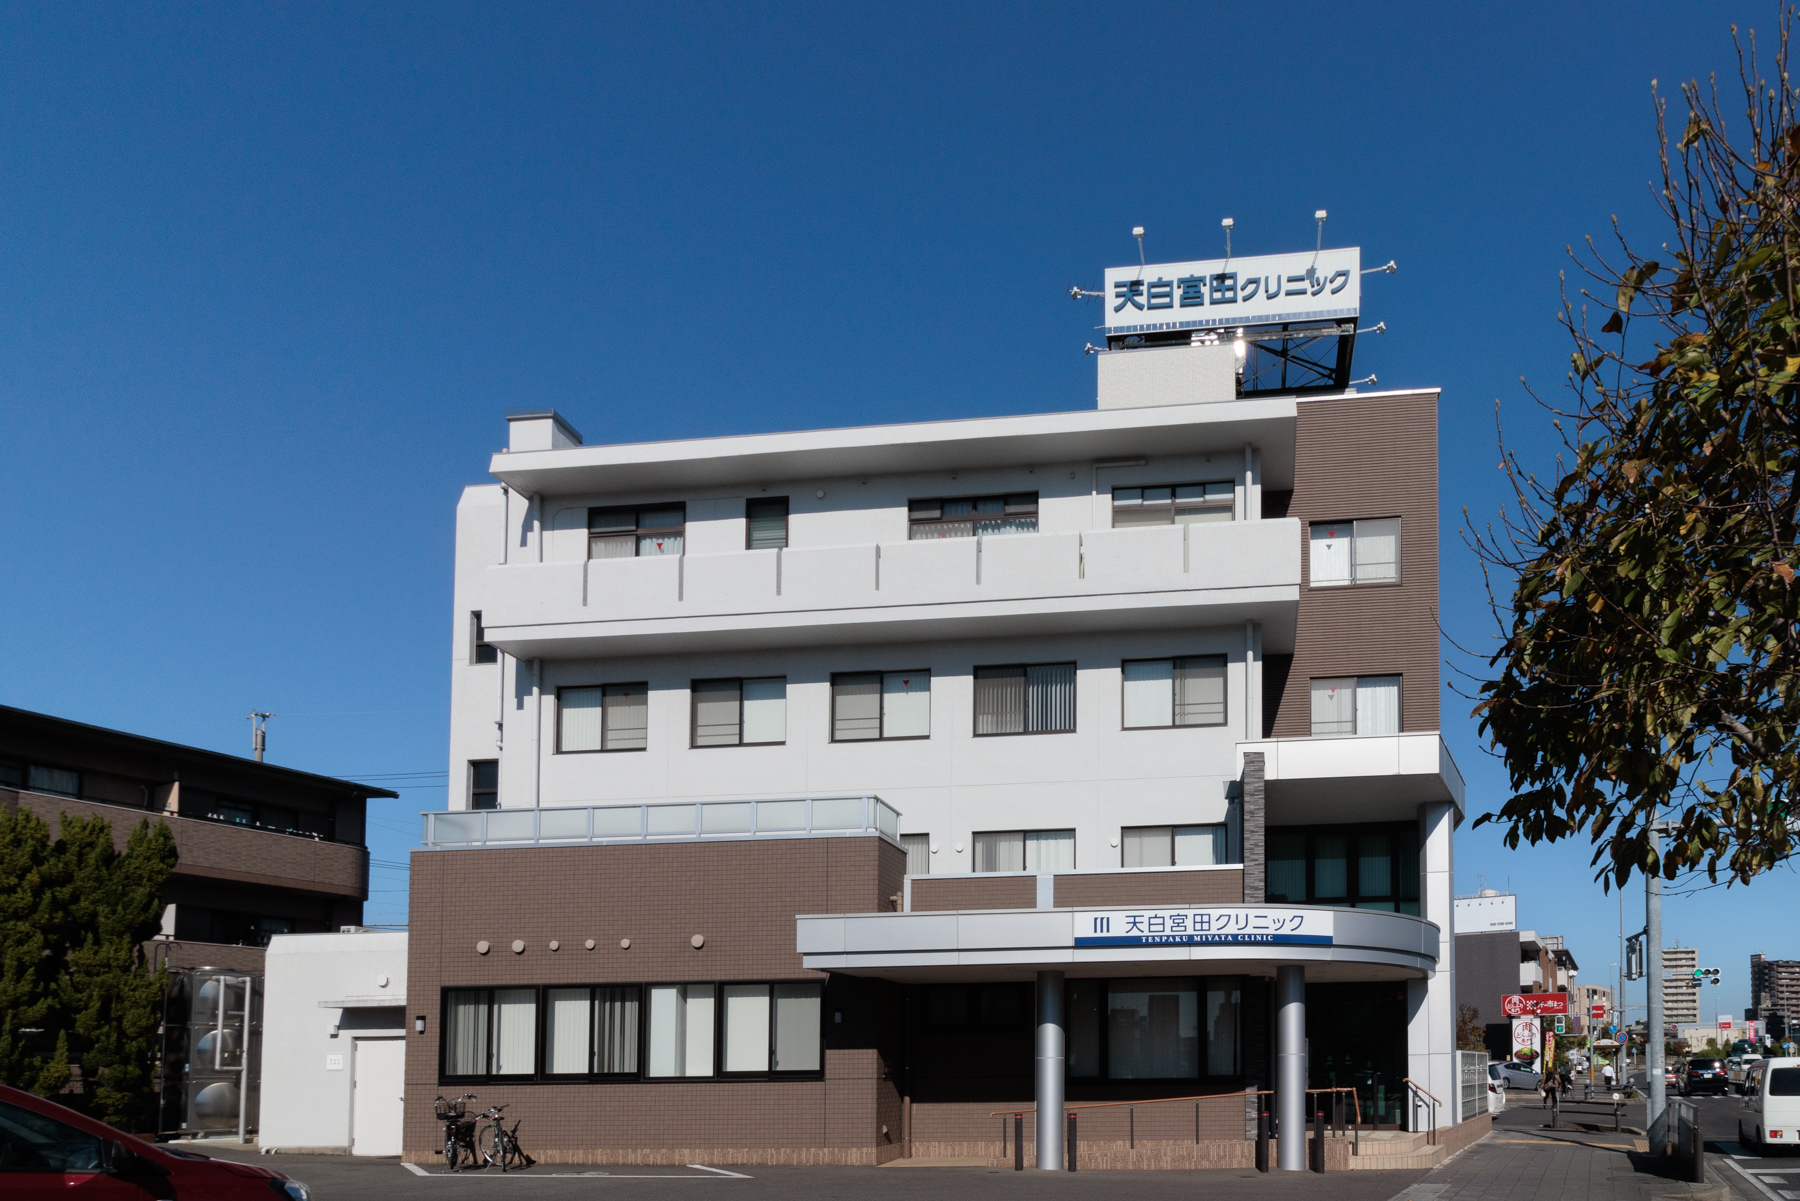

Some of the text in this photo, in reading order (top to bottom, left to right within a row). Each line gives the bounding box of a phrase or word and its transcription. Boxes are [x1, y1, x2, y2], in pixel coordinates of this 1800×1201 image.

[1113, 269, 1350, 313] 天白宮田クリニック
[1125, 913, 1304, 933] 天白宮田クリニック
[1141, 934, 1274, 943] TENPAKU MIYATA CLINIC
[1522, 1022, 1531, 1032] 肉
